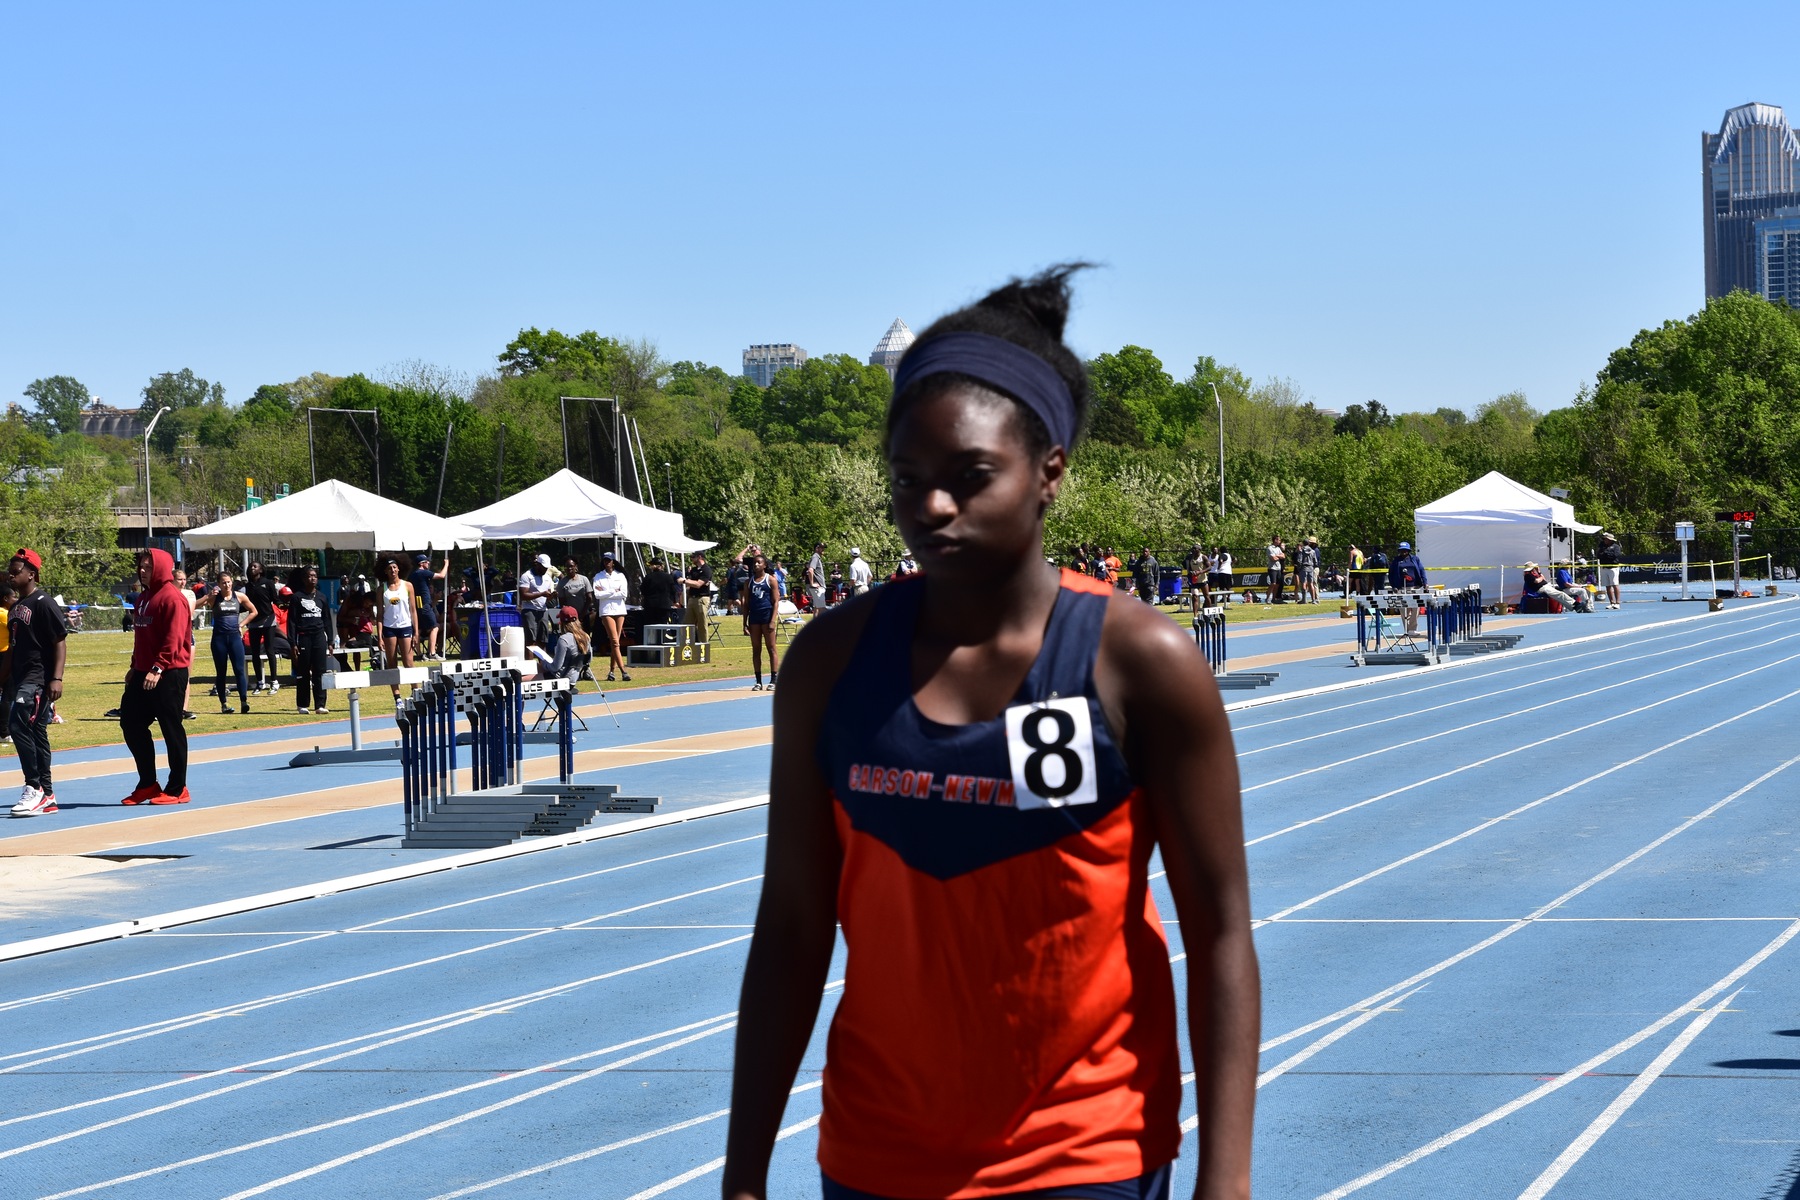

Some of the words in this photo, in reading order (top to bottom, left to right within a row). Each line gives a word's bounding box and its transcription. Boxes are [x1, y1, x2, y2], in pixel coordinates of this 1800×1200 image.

[686, 626, 690, 639] 1
[670, 647, 675, 660] 2
[700, 644, 705, 657] 3
[471, 660, 492, 671] UCS
[523, 682, 543, 693] UCS
[1021, 708, 1084, 799] 8
